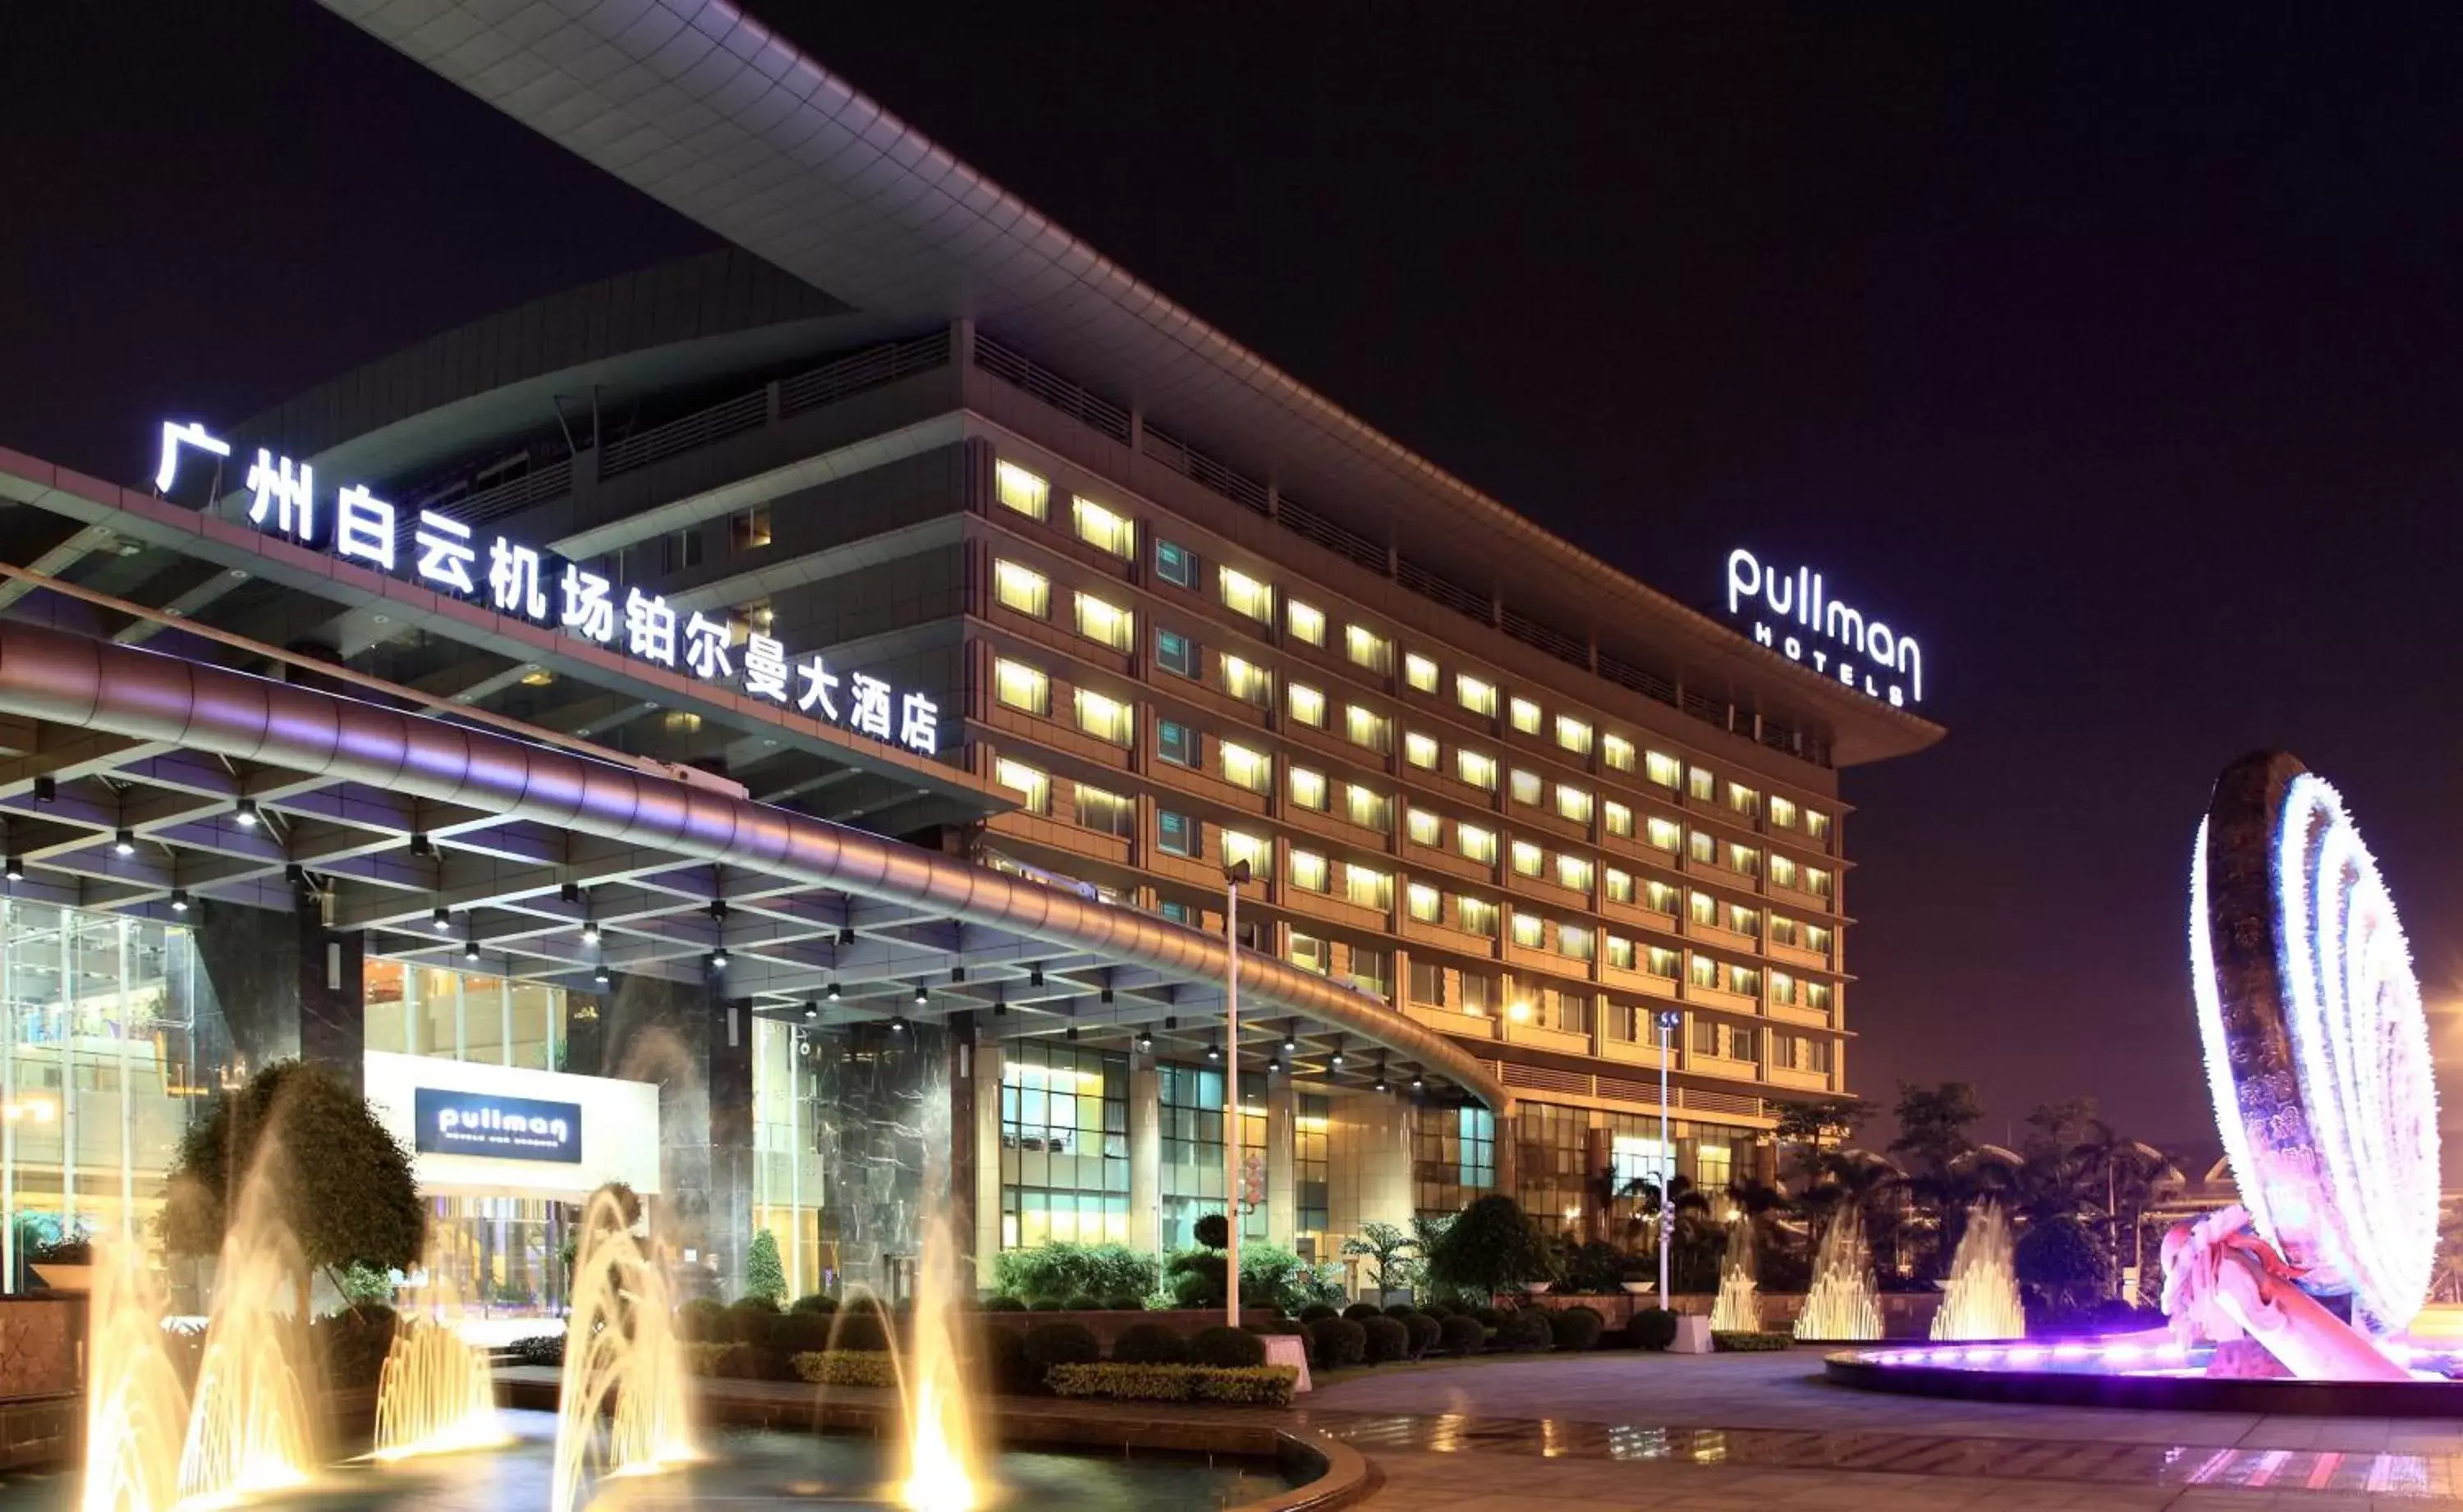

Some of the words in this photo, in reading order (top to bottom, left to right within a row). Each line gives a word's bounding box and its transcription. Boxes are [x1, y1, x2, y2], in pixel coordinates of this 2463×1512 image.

[155, 421, 938, 754] 广州白云机场铂尔曼大酒店
[1728, 548, 1921, 702] pullman
[1754, 621, 1904, 707] HOTELS
[438, 1107, 568, 1143] pullman
